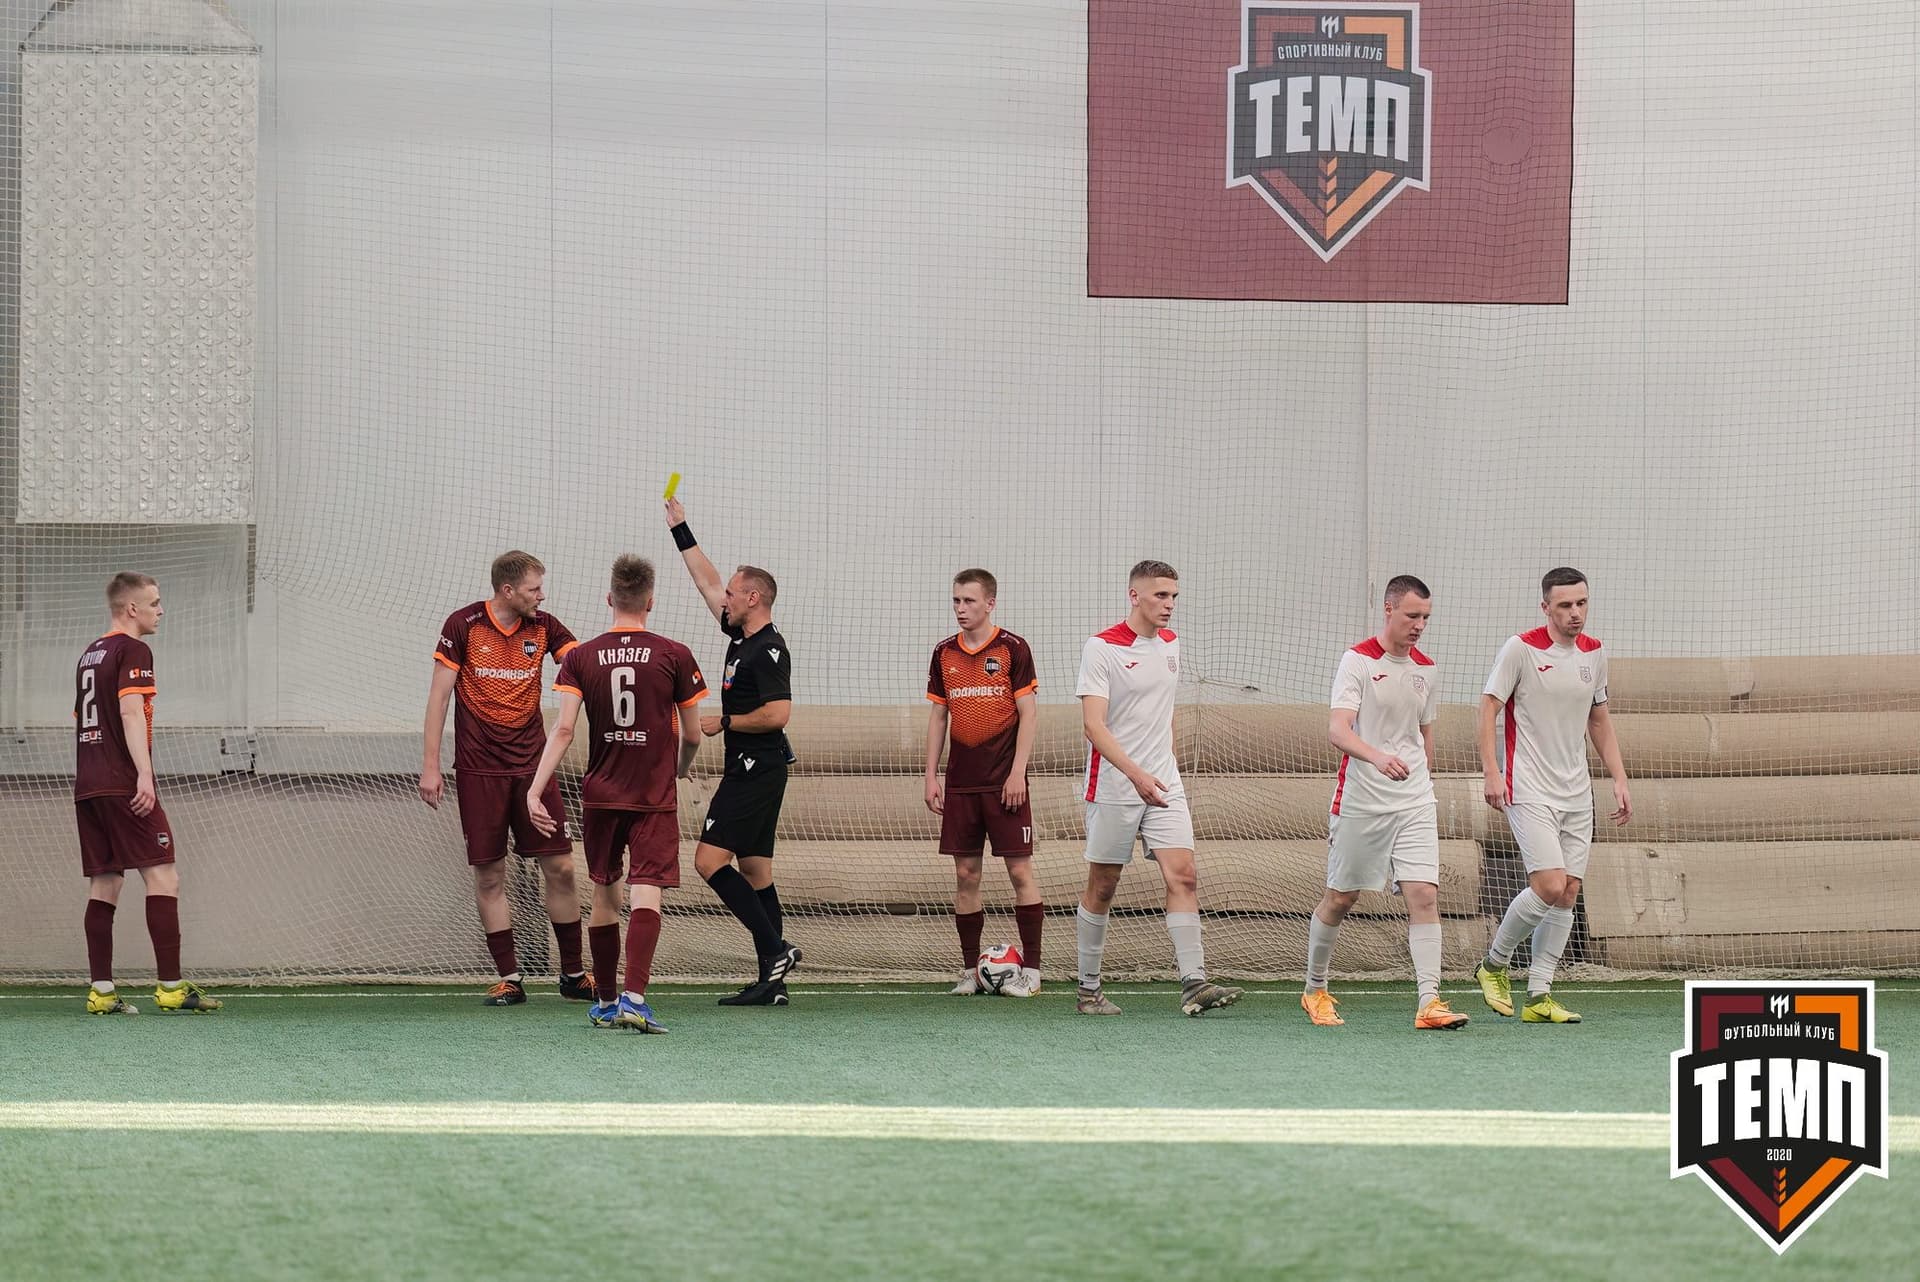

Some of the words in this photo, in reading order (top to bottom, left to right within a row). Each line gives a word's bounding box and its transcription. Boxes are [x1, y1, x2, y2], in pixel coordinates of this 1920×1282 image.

[1277, 42, 1351, 60] СПОРТИВНЫЙ
[1354, 46, 1383, 61] КЛУБ
[1249, 76, 1410, 162] ТЕМП
[598, 647, 651, 666] КНЯЗЕВ
[82, 669, 98, 728] 2
[611, 667, 635, 727] 6
[603, 730, 647, 742] SEUS
[1022, 827, 1031, 844] 17
